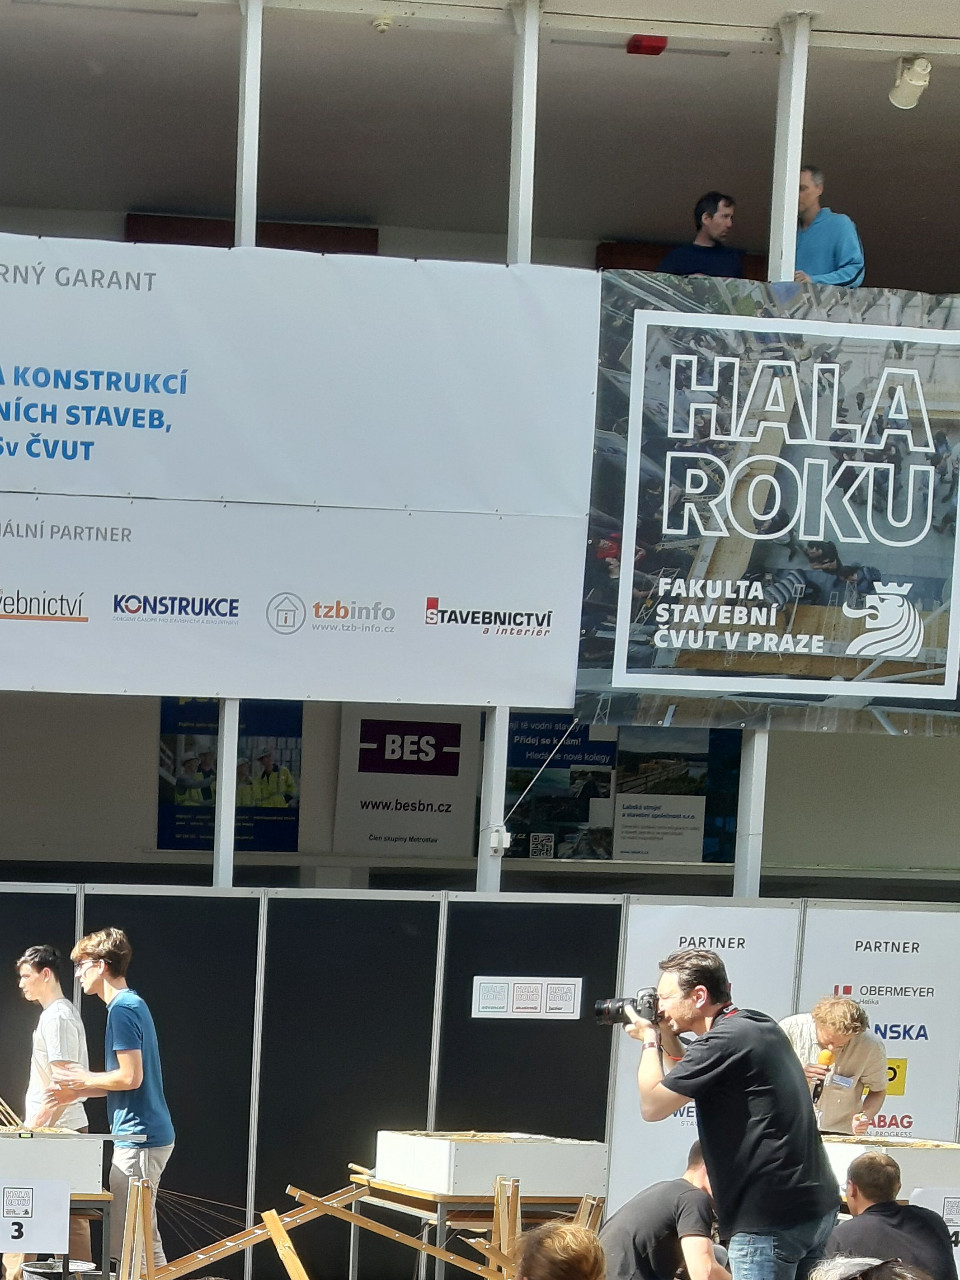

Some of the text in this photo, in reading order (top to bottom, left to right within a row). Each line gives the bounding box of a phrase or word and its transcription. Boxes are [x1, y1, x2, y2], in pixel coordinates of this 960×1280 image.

[54, 265, 157, 292] GARANT
[13, 364, 188, 395] KONSTRUKCÍ
[667, 354, 936, 453] HALA
[65, 404, 172, 434] STAVEB,
[26, 431, 95, 461] ČVUT
[662, 451, 935, 547] ROKU
[50, 523, 132, 544] PARTNER
[658, 578, 764, 600] FAKULTA
[113, 594, 240, 618] KONSTRUKCE
[313, 600, 395, 621] tzbinfo
[654, 601, 778, 625] STAVEBNÍ
[311, 623, 395, 633] www.tzb-info.cz
[425, 608, 553, 627] STAVEBNICTVÍ
[495, 626, 551, 637] interiér
[654, 625, 824, 653] ČVUT V PRAZE
[385, 733, 437, 762] BES
[526, 751, 561, 760] Hledáe
[360, 799, 452, 813] www.besbn.cz
[679, 936, 746, 949] PARTNER
[855, 940, 920, 953] PARTNER
[859, 985, 935, 998] OBERMEYER
[874, 1023, 929, 1041] NSKA
[867, 1114, 914, 1129] ABAG
[11, 1221, 24, 1240] 3
